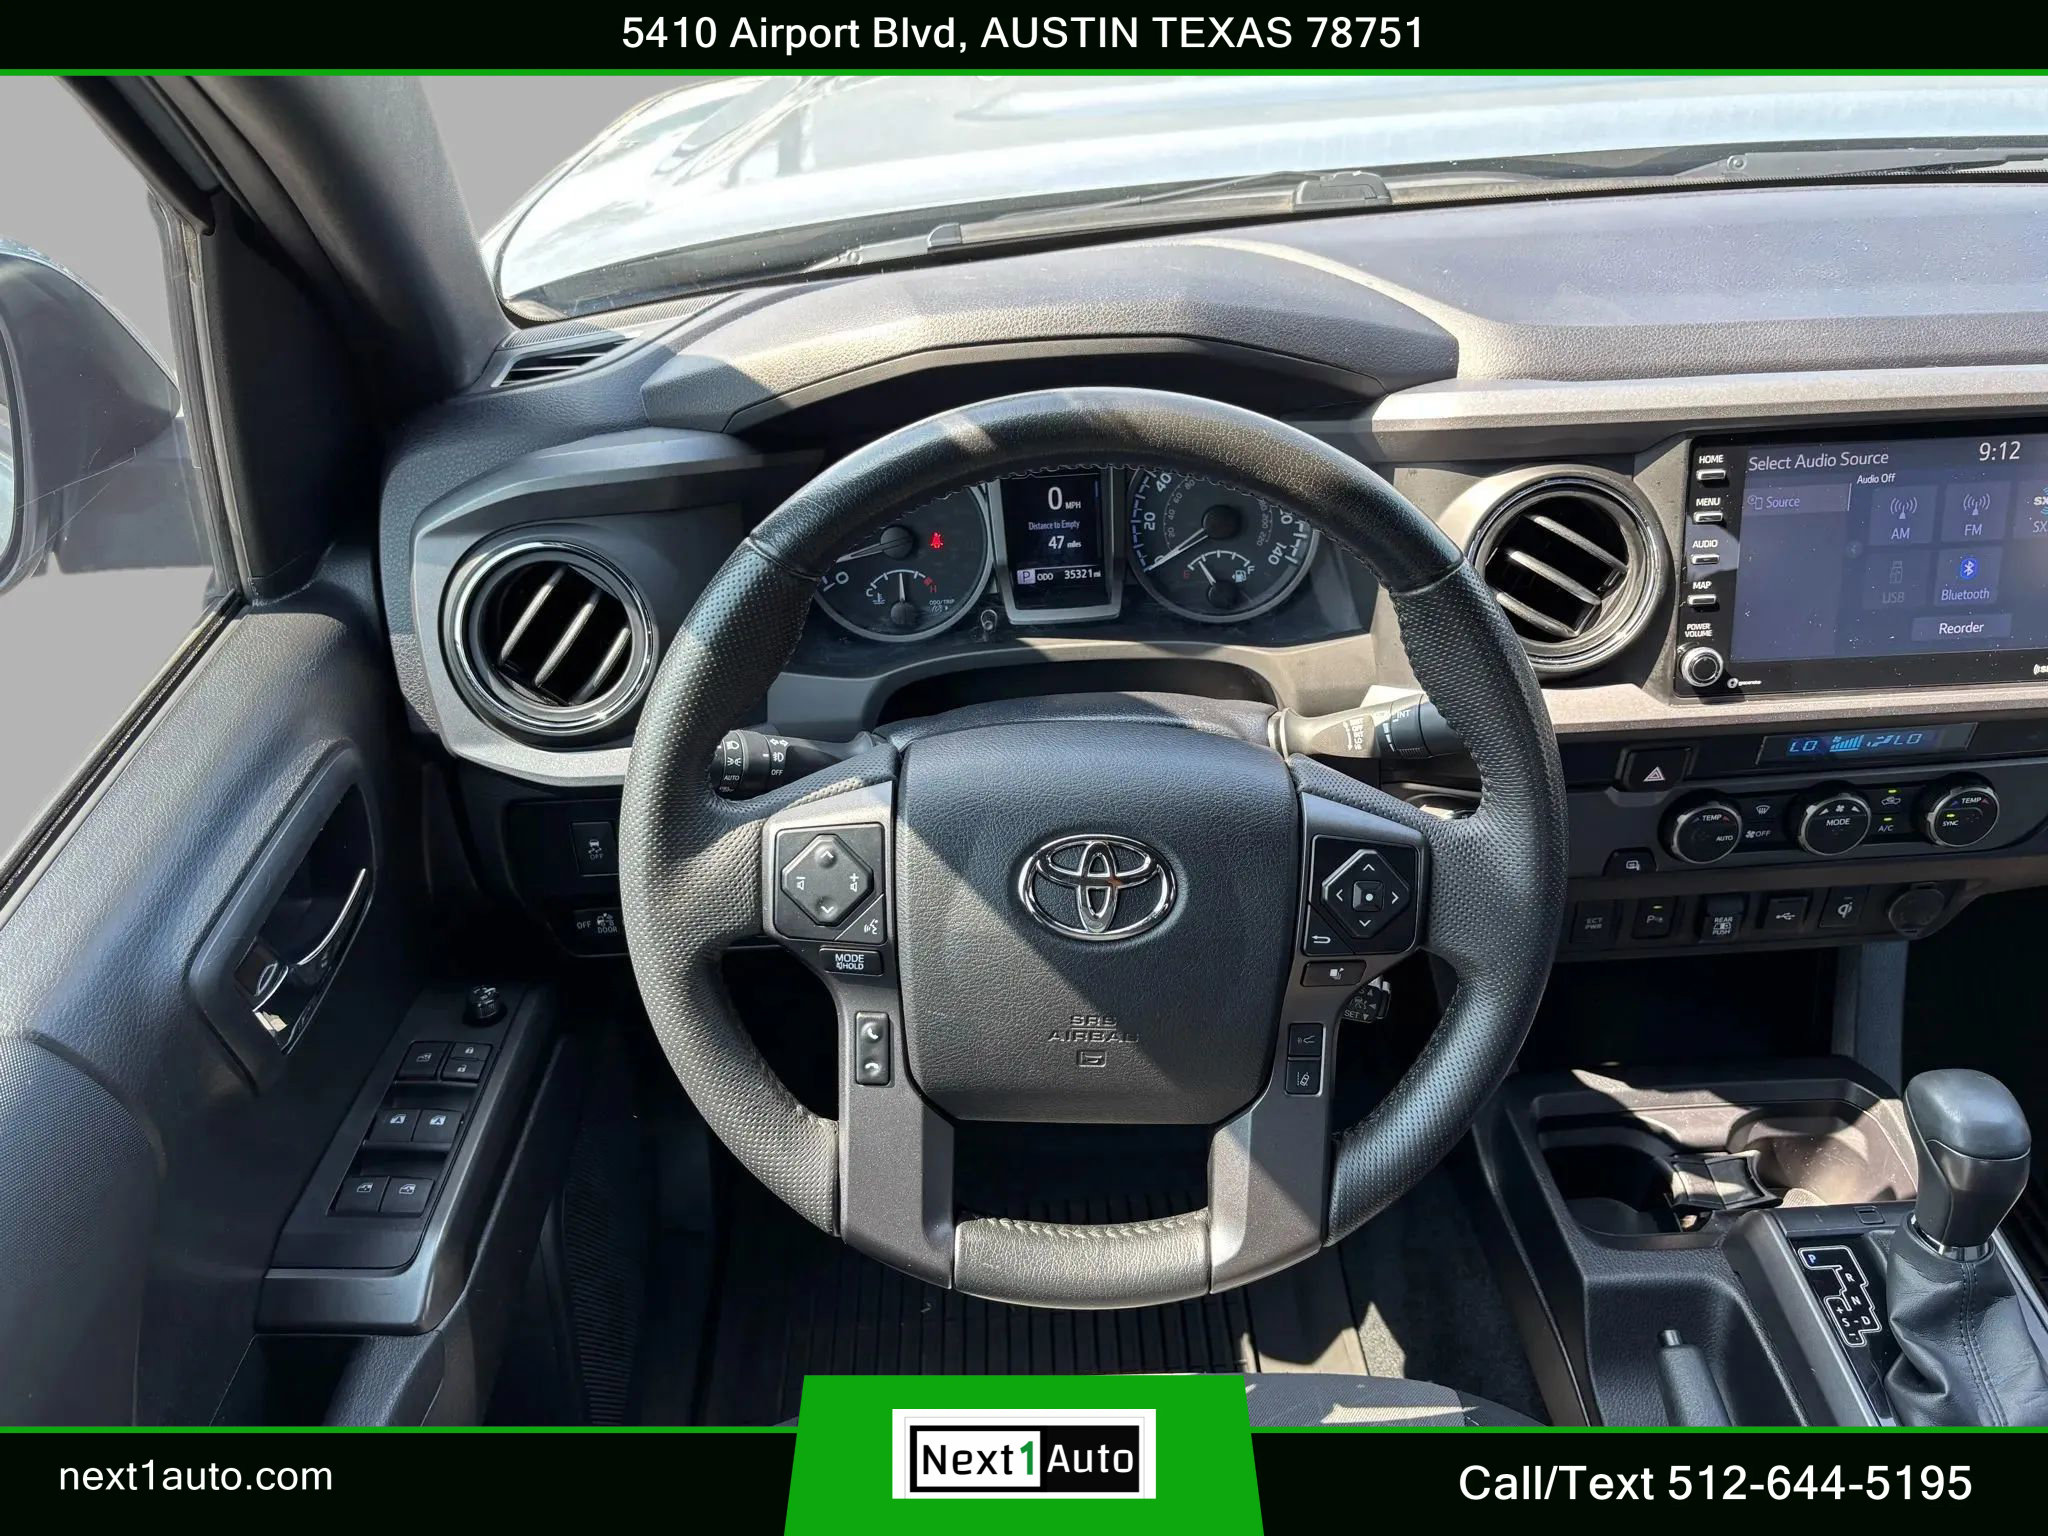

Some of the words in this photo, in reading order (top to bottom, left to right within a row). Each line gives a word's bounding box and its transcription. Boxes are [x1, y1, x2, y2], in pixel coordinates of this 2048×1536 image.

[1979, 441, 2021, 461] 9:12
[1698, 454, 1724, 464] HOME
[1748, 456, 1792, 472] Select
[1794, 453, 1837, 469] Audio
[1839, 451, 1889, 467] Source
[1156, 473, 1172, 492] 40
[1857, 473, 1879, 484] Audio
[1880, 472, 1896, 483] Off
[1048, 486, 1063, 510] 0
[1065, 501, 1082, 509] MPH
[1695, 497, 1721, 507] MENU
[1765, 496, 1801, 509] Source
[1028, 521, 1053, 531] Distance
[1054, 521, 1061, 529] to
[1061, 520, 1080, 530] Empty
[1144, 512, 1156, 531] 20
[1890, 527, 1910, 540] AM
[1964, 524, 1983, 536] FM
[1048, 536, 1065, 549] 47
[1692, 539, 1718, 549] AUDIO
[1268, 542, 1287, 565] 140
[1022, 571, 1031, 582] P
[1037, 573, 1054, 581] ODO
[1064, 570, 1093, 579] 35321
[1692, 581, 1712, 590] MAP
[1882, 592, 1905, 604] USB
[1941, 587, 1990, 601] Bluetooth
[1686, 622, 1711, 631] POWER
[1938, 621, 1985, 635] Reorder
[1685, 629, 1713, 638] VOLUME
[1702, 814, 1722, 822] TEMP
[1826, 818, 1850, 826] MODE
[1878, 824, 1894, 832] A/C
[1755, 830, 1771, 838] OFF
[576, 921, 591, 929] OFF
[597, 926, 618, 934] DOOR
[835, 954, 864, 964] MODE
[842, 962, 864, 970] HOLD
[1344, 1009, 1360, 1018] SET
[1071, 1015, 1117, 1026] SRS
[1049, 1030, 1140, 1043] AIRBAG
[1807, 1254, 1816, 1263] P
[1845, 1272, 1856, 1282] R
[1850, 1296, 1861, 1306] N
[1841, 1318, 1850, 1327] S
[1861, 1316, 1871, 1325] D
